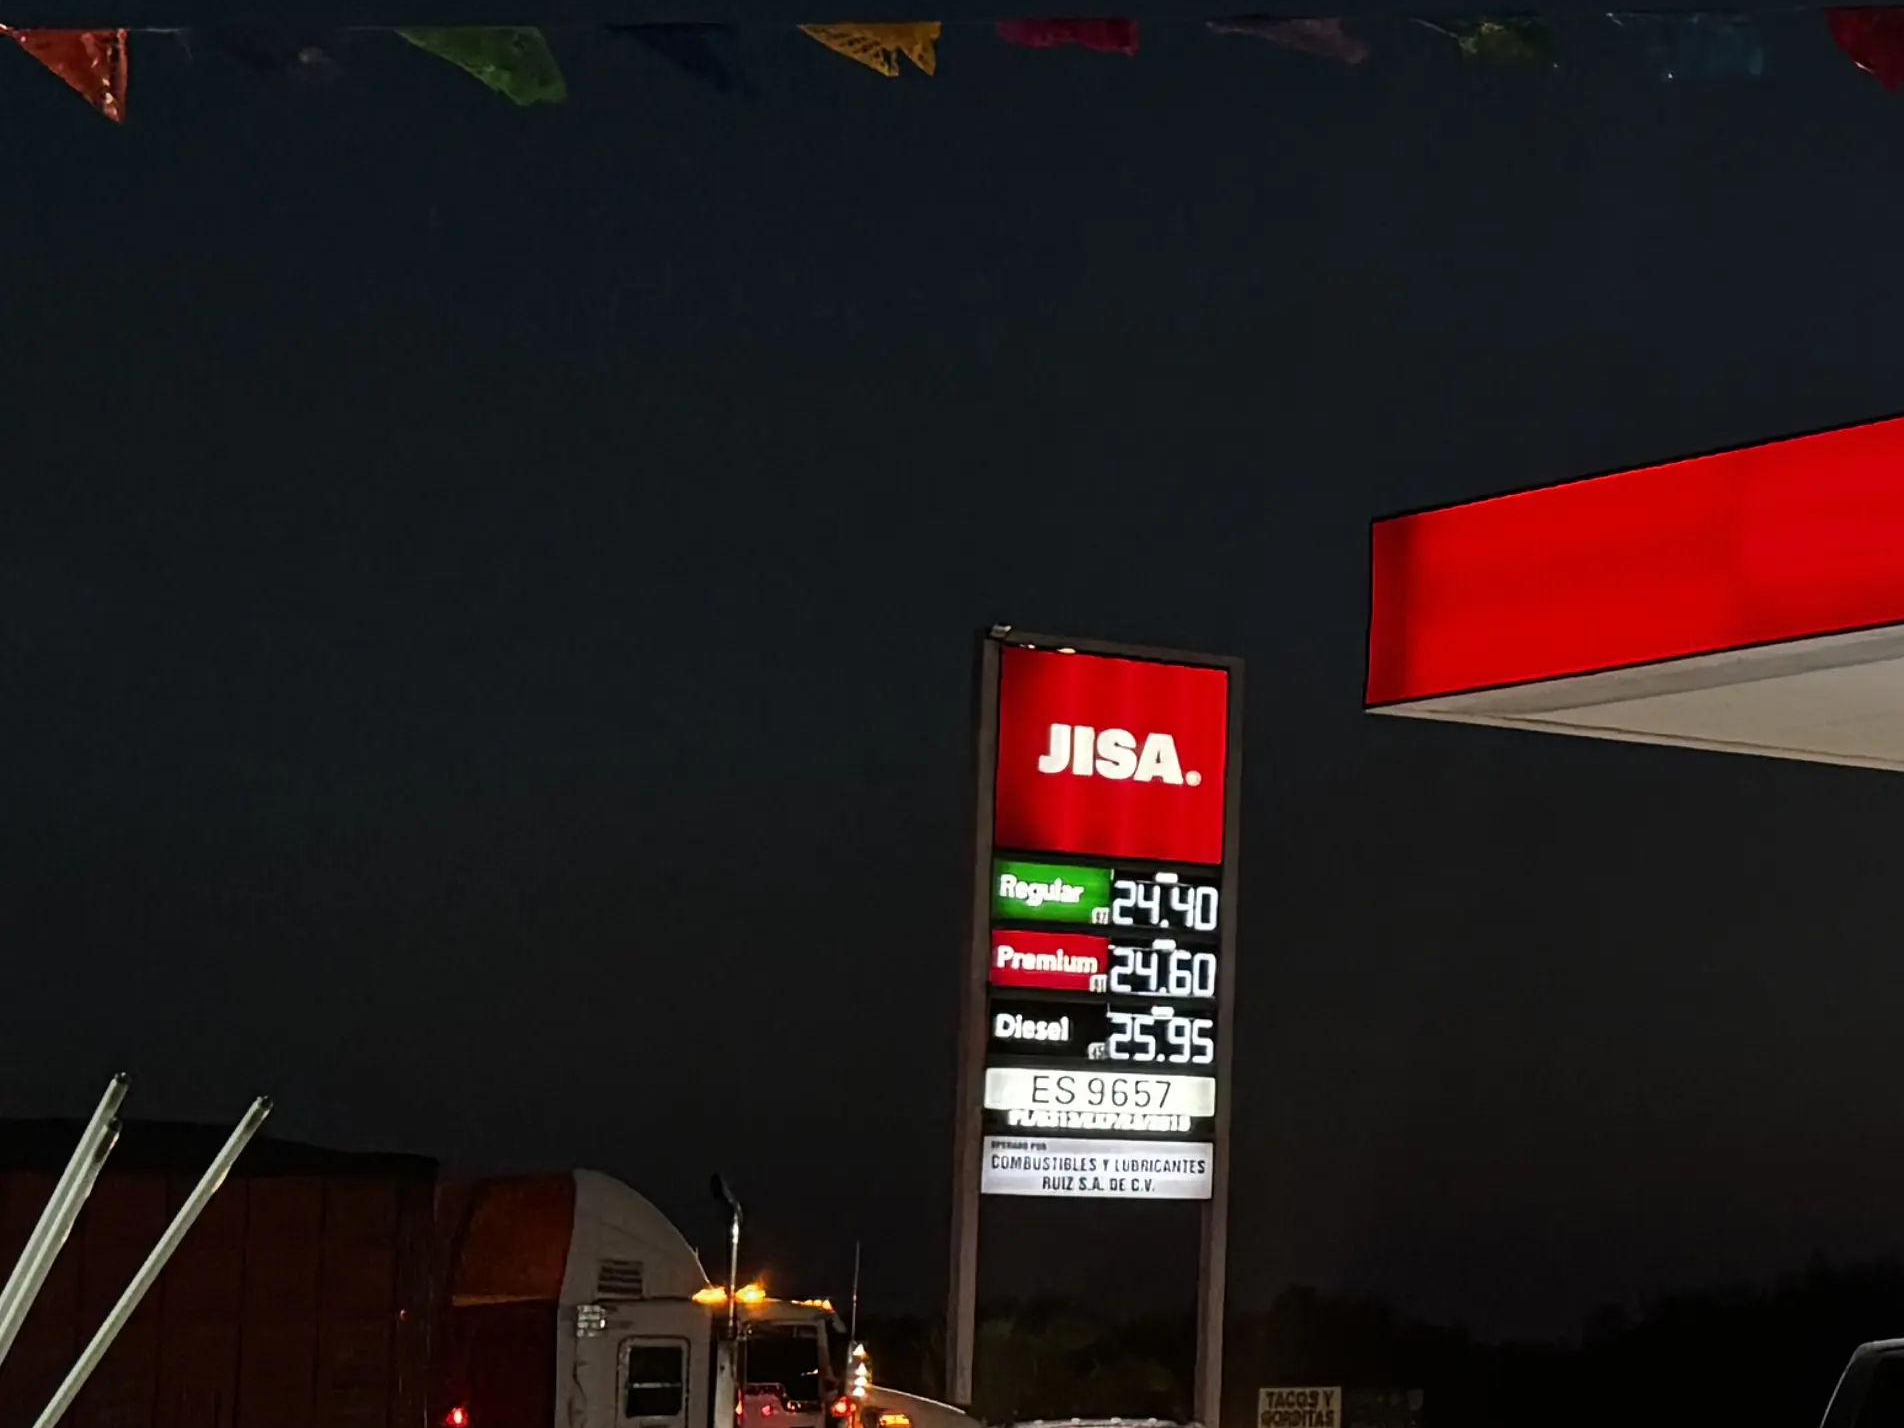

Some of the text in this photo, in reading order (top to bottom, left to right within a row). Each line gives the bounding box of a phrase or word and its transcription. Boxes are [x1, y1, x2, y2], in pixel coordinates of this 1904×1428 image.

[999, 874, 1085, 907] Regular
[1112, 880, 1219, 931] 24.40
[996, 945, 1098, 973] Premium
[1110, 948, 1216, 997] 24.60
[994, 1013, 1069, 1042] Diesel
[1108, 1015, 1214, 1064] 25.95
[1032, 1075, 1172, 1109] ES 9657
[991, 1154, 1206, 1174] COMBUSTIBLES Y LUBRICANTES
[1042, 1176, 1073, 1191] RUIZ
[1079, 1176, 1104, 1192] S.A.
[1109, 1177, 1126, 1192] DE
[1266, 1390, 1334, 1409] TACOS Y
